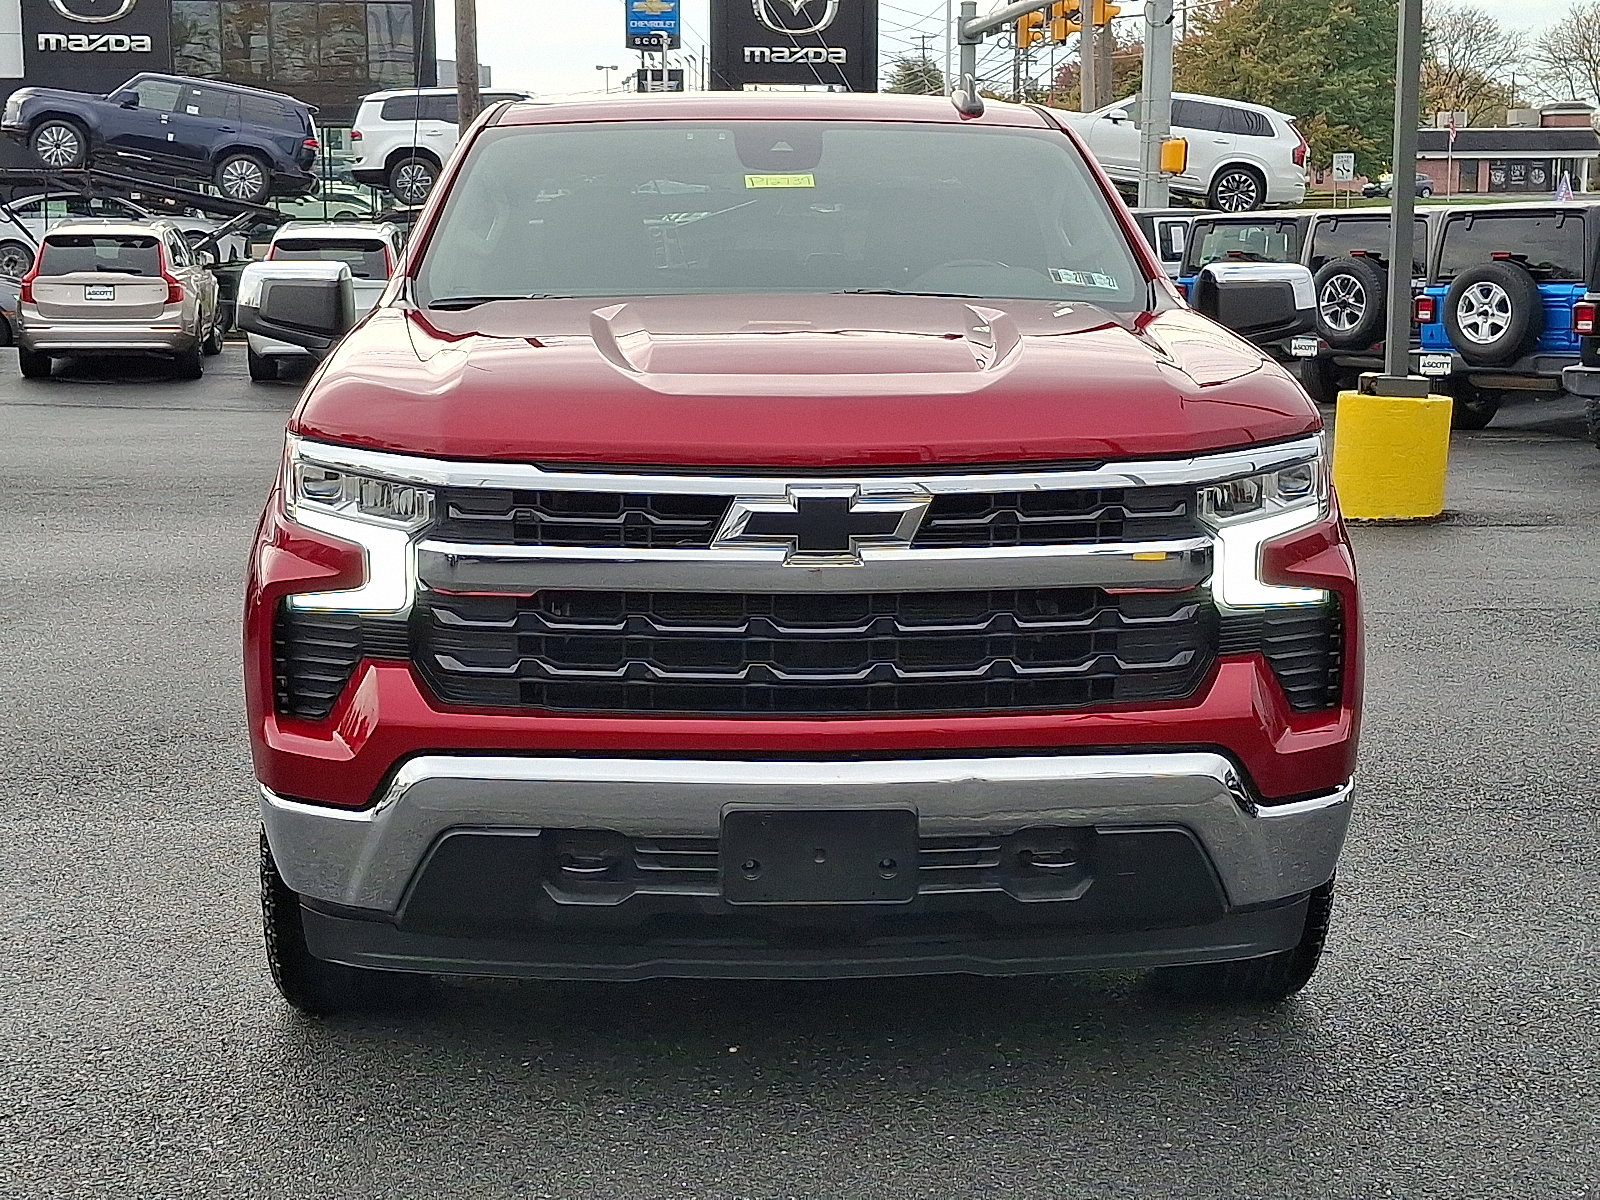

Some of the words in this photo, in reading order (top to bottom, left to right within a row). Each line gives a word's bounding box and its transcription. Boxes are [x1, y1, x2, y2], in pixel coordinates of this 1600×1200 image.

[630, 20, 676, 28] CHEVROLET
[37, 33, 152, 52] mazda
[743, 46, 847, 64] mazda
